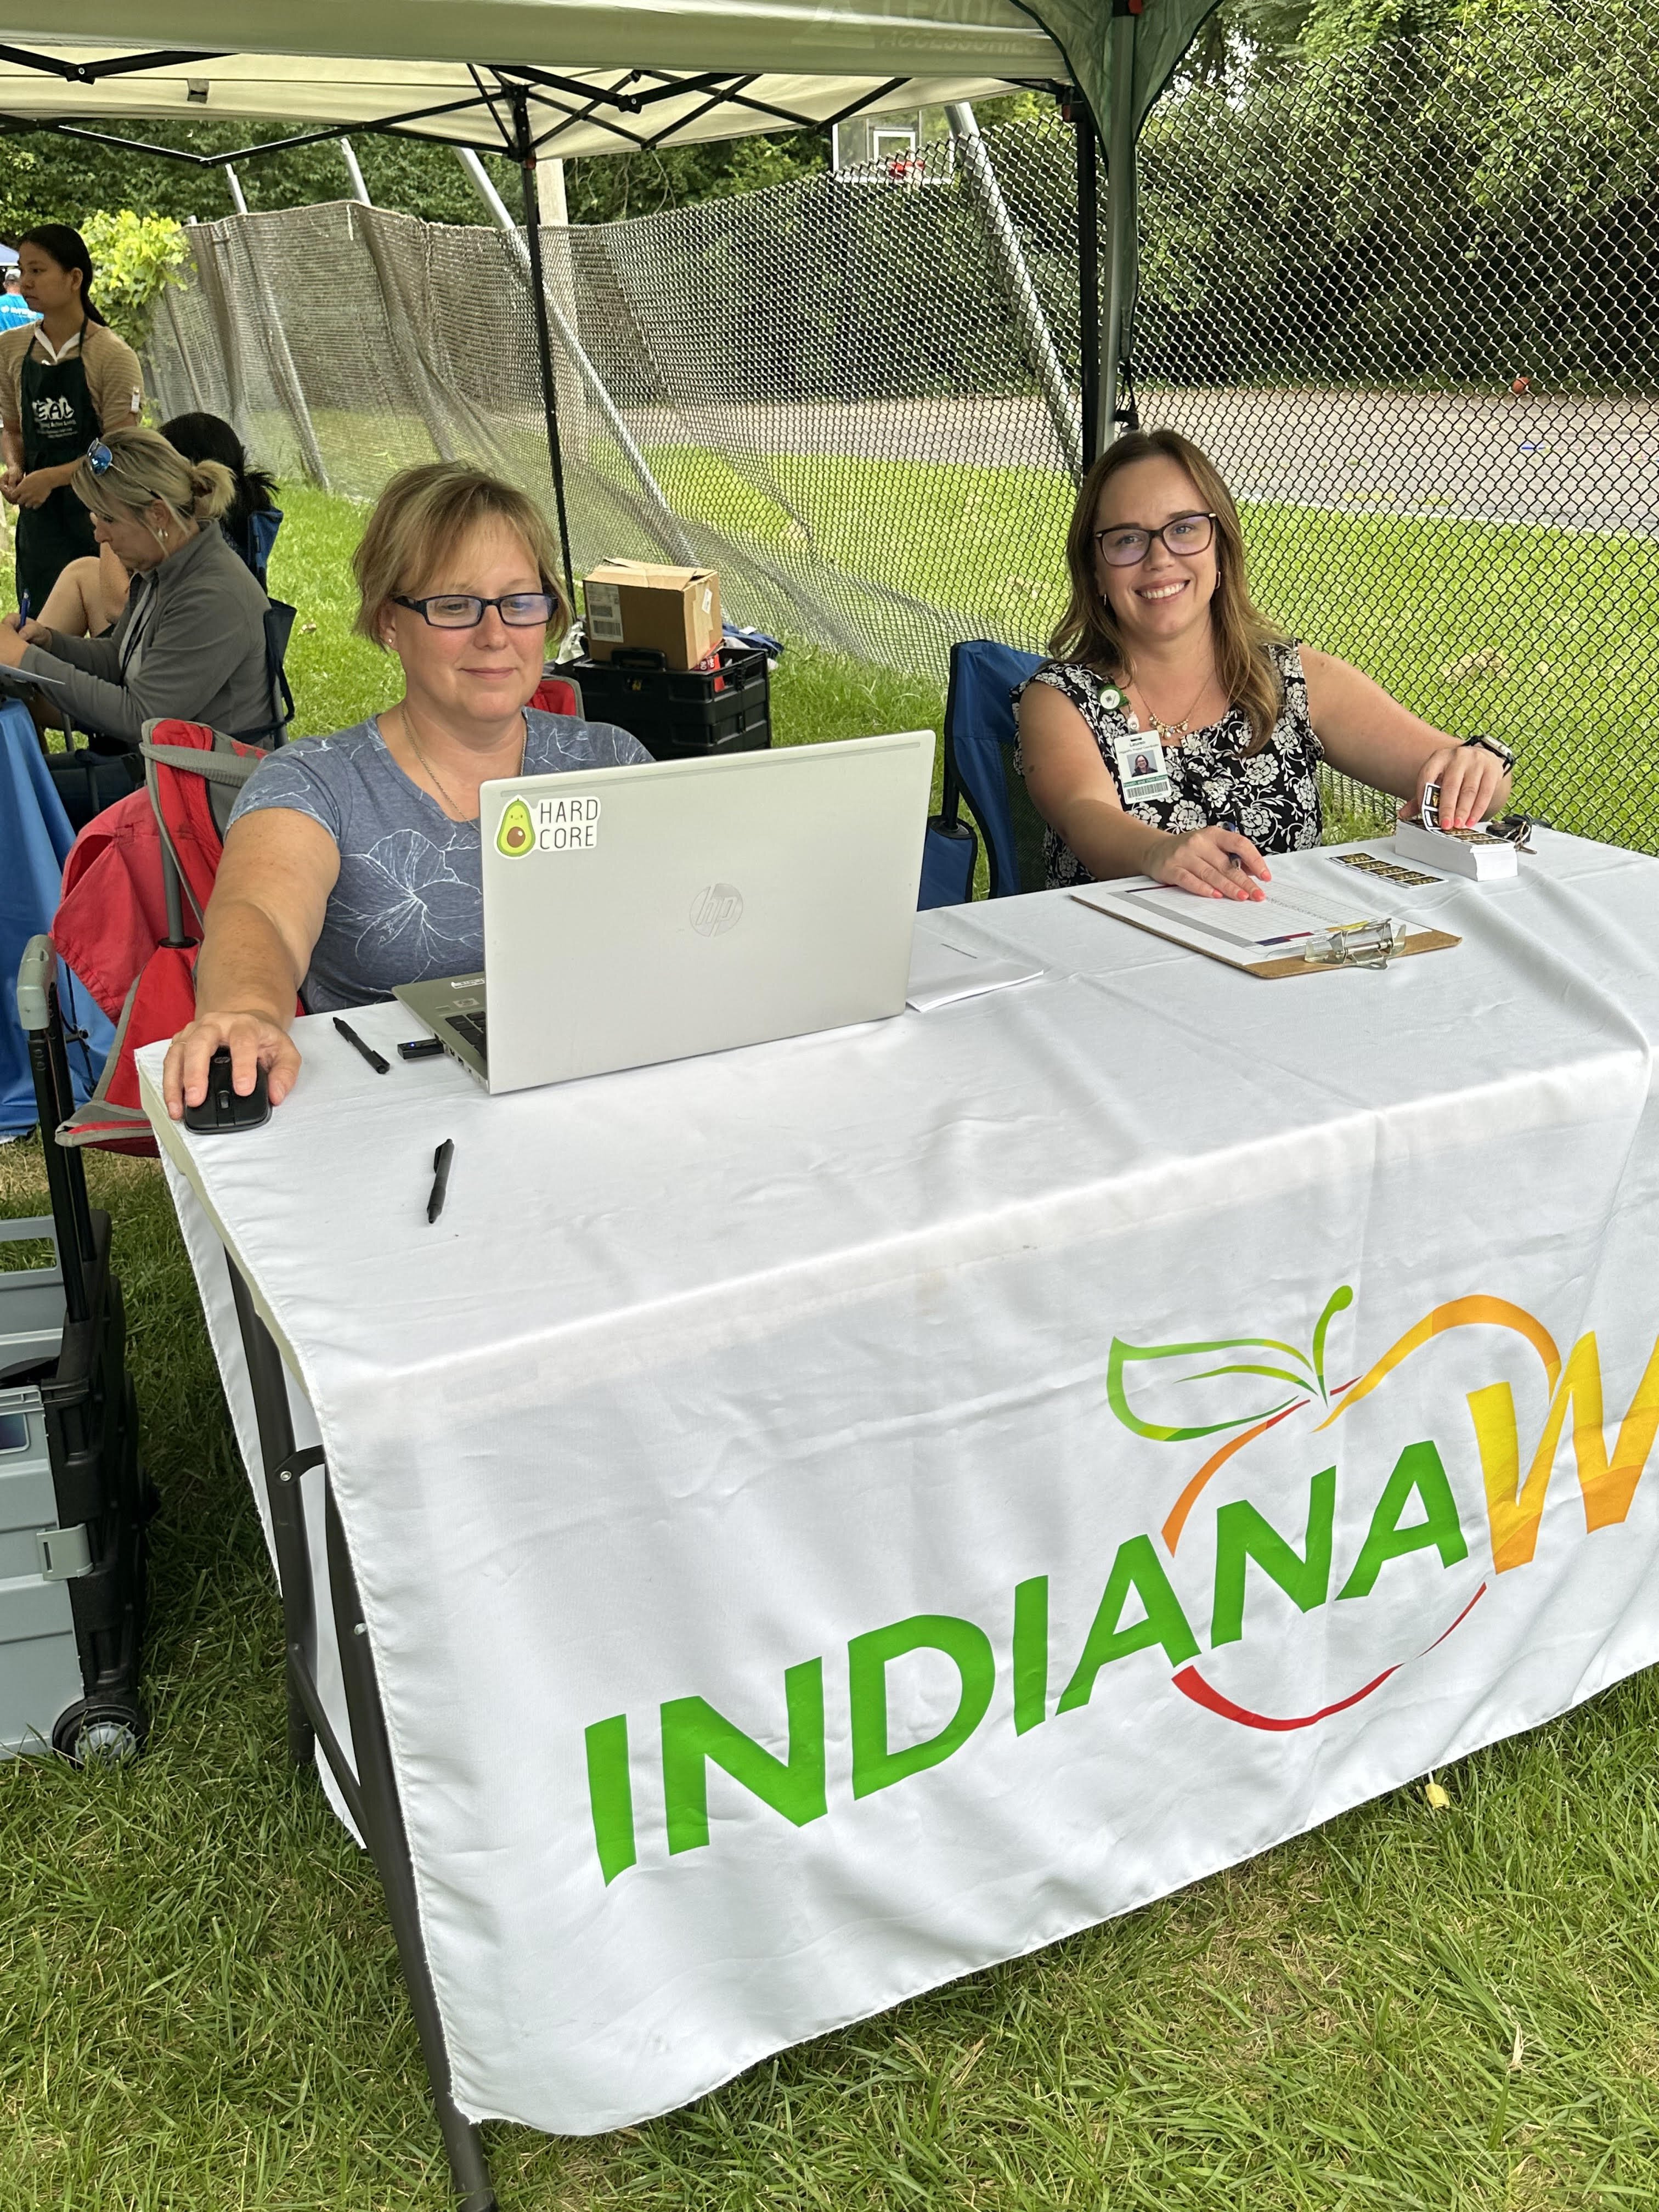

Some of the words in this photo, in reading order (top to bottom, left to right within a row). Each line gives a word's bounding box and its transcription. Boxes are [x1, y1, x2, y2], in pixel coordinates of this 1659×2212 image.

[540, 799, 598, 824] HARD
[540, 826, 594, 850] CORE
[692, 883, 741, 937] hp
[584, 1440, 1469, 1886] INDIANA
